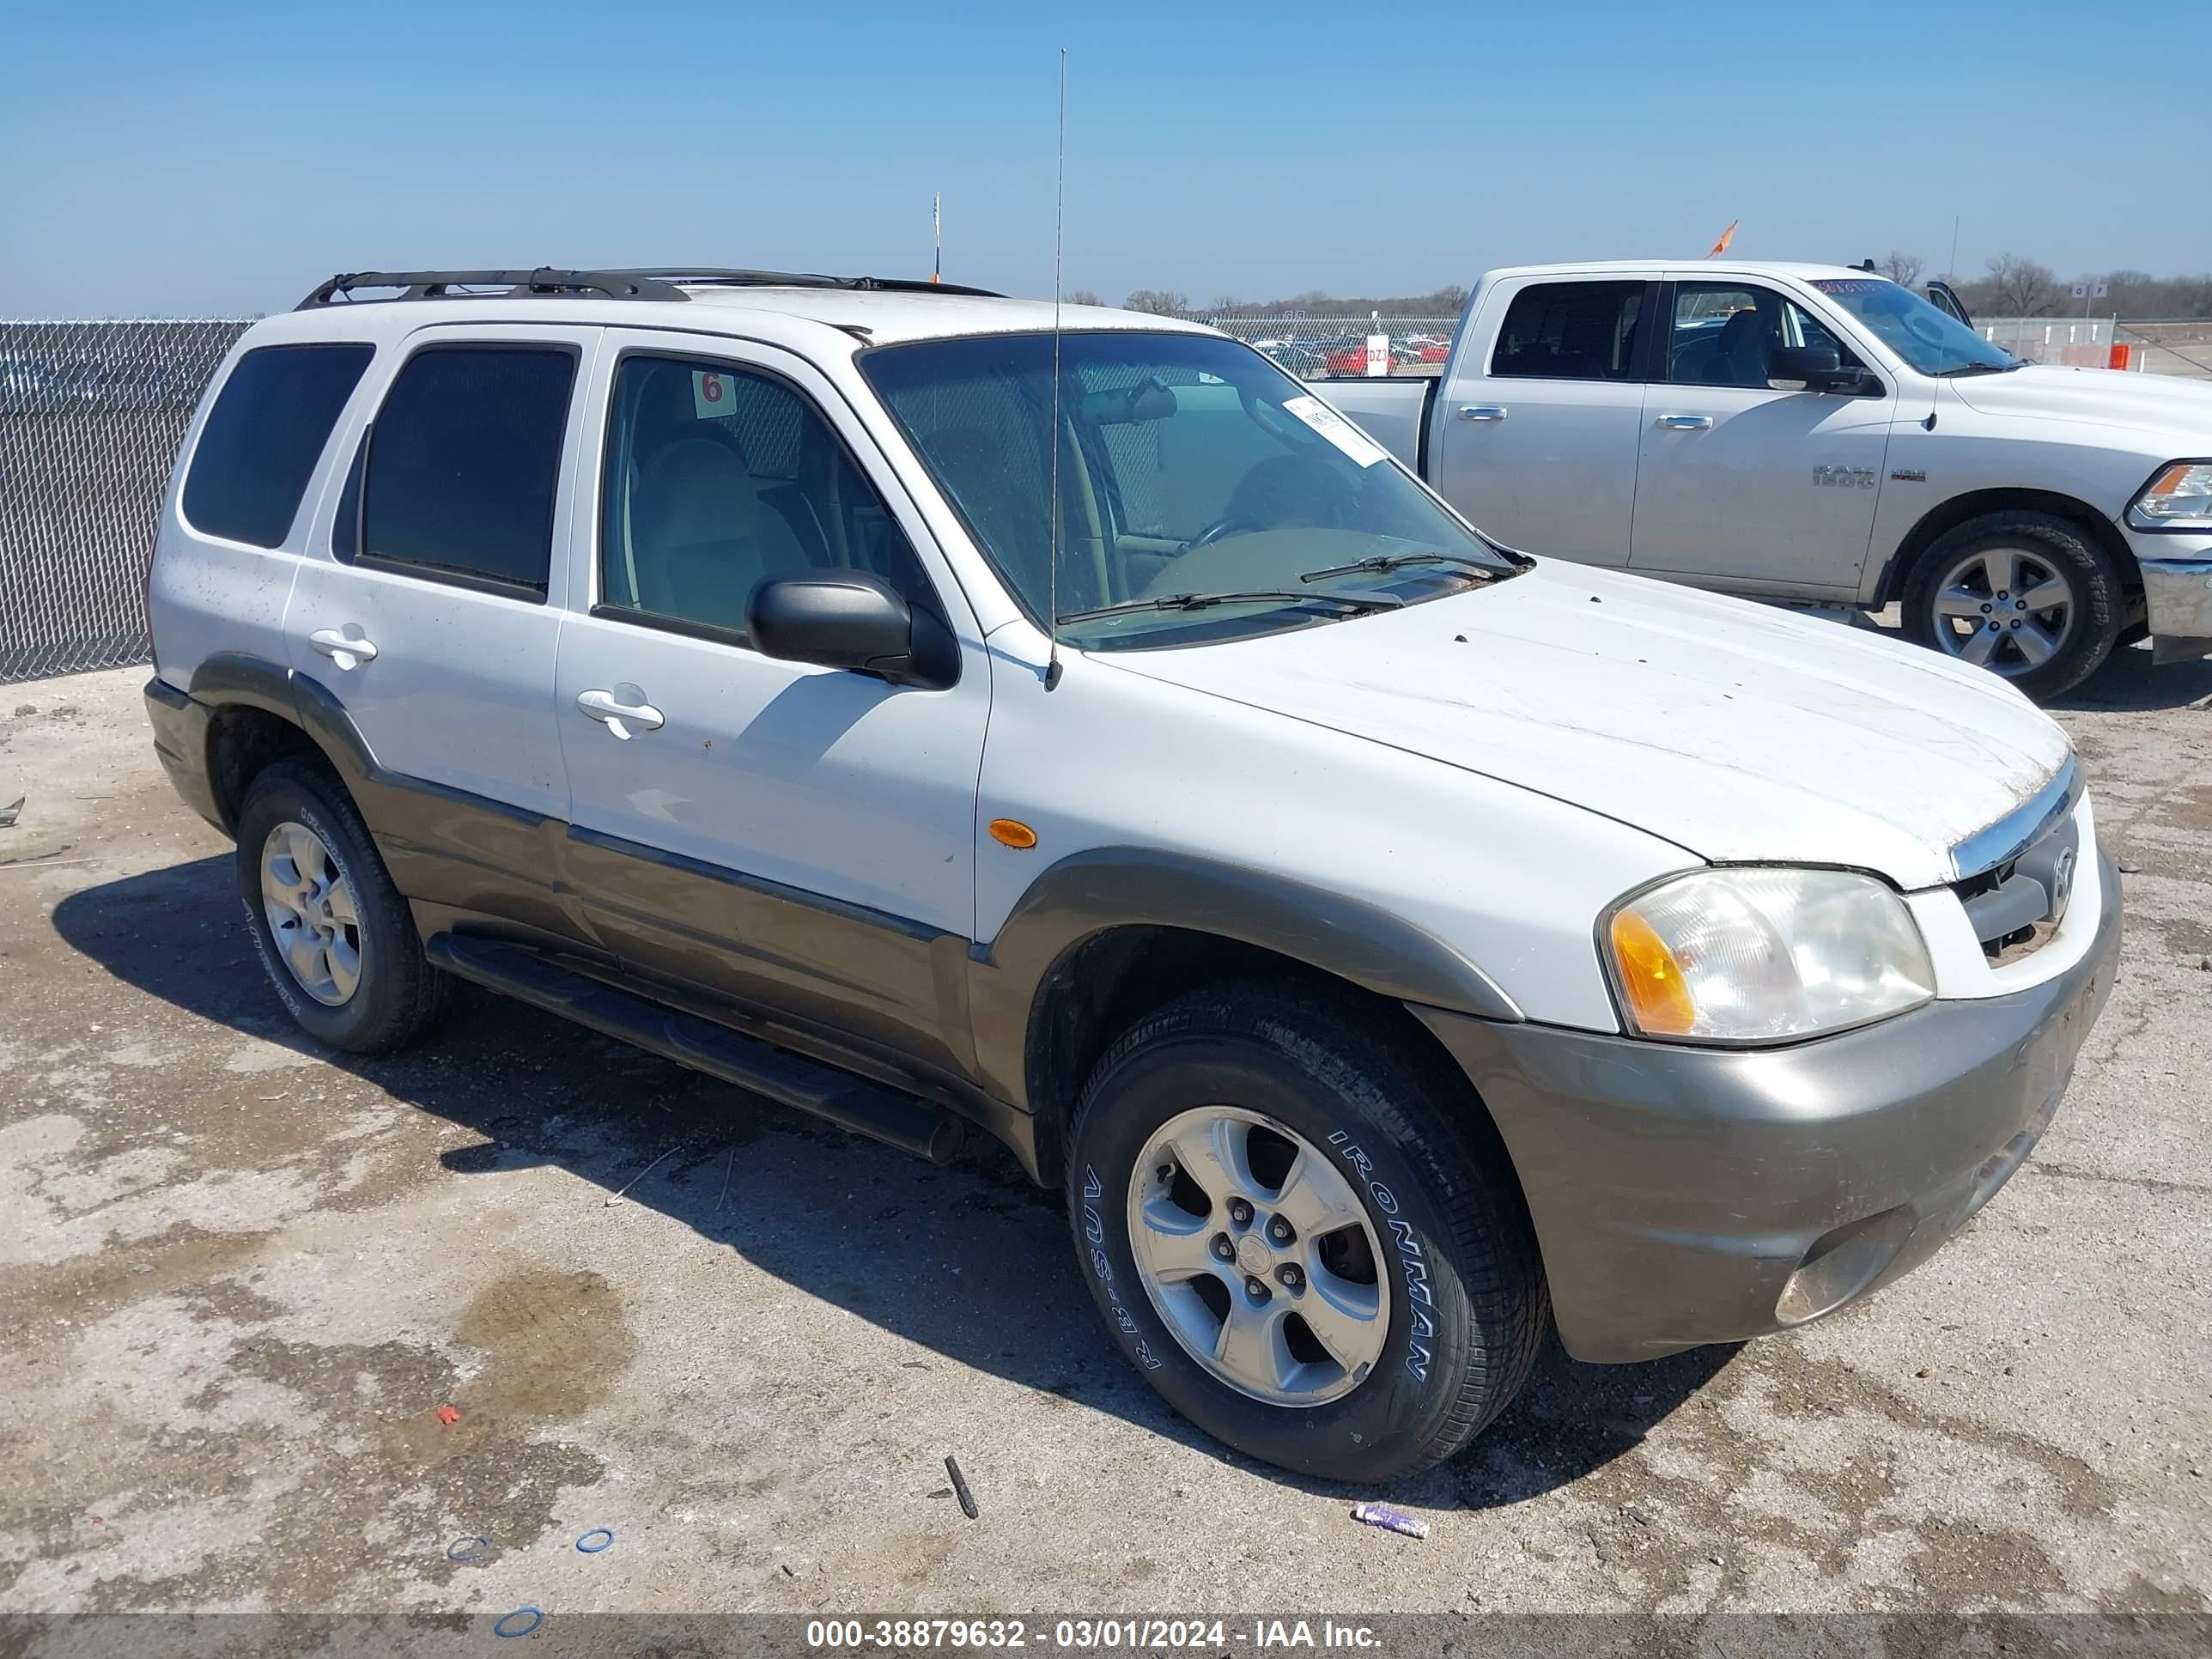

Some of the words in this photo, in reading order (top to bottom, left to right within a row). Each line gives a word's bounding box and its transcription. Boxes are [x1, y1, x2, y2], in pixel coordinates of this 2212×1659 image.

[1369, 349, 1388, 362] DZ3
[702, 371, 724, 403] 6
[1813, 475, 1875, 489] 1500
[1328, 1130, 1433, 1382] IRONMAN
